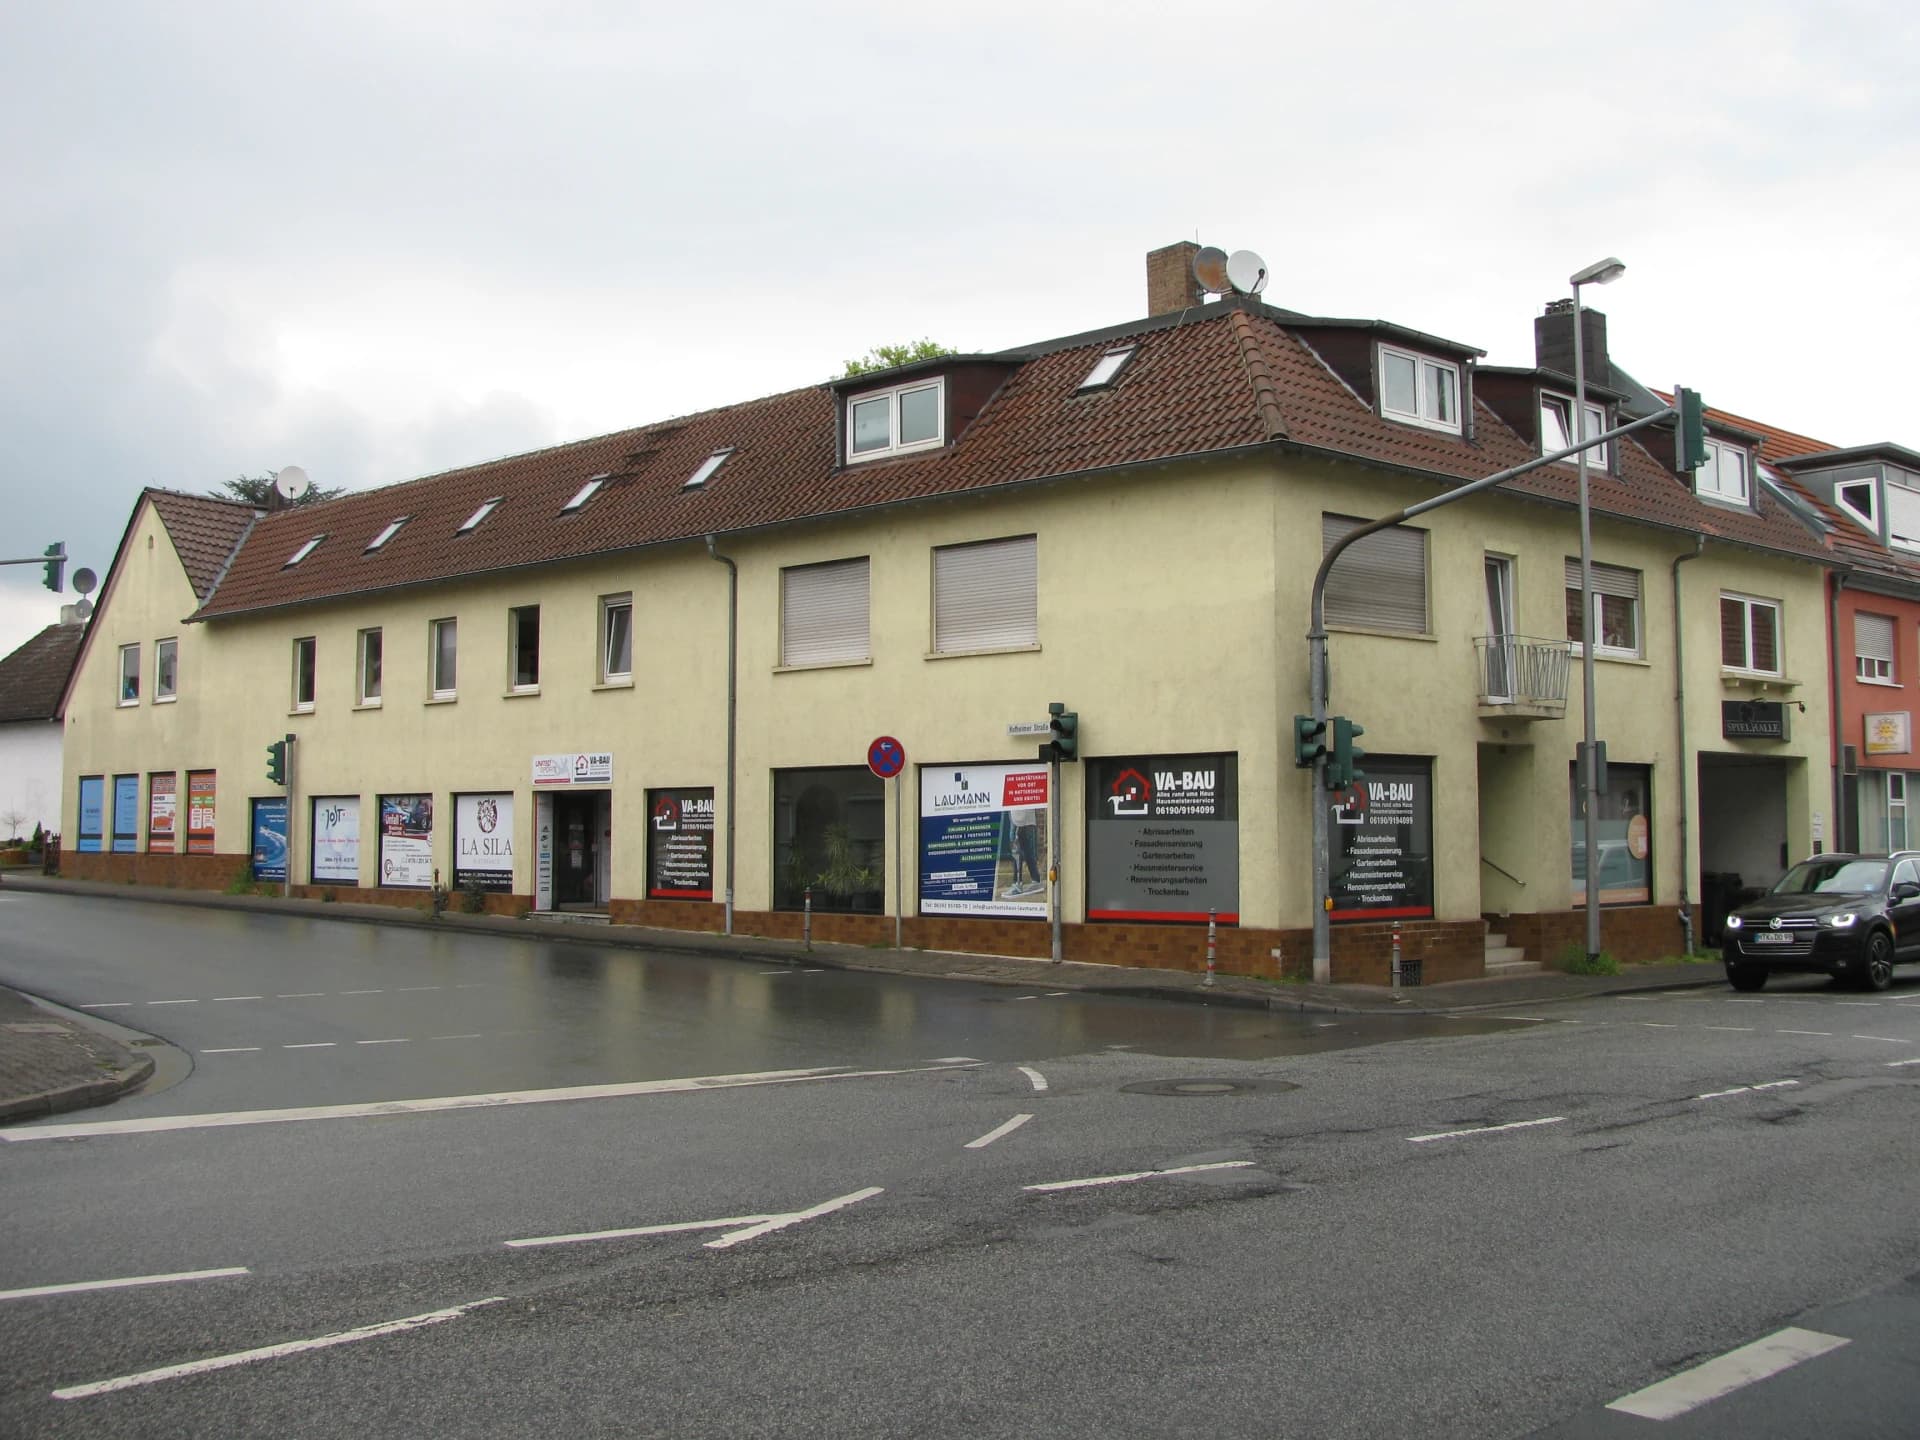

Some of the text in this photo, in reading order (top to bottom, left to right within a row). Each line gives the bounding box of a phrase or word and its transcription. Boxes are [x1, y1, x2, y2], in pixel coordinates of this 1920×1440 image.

[1154, 770, 1215, 790] VA-BAU
[1368, 783, 1413, 801] VA-BAU
[934, 792, 990, 806] LAUMANN
[1155, 805, 1215, 815] 06190/9194099
[462, 838, 512, 855] LA SILA
[1350, 847, 1402, 855] Fassadensanierung
[1356, 859, 1397, 867] Gartenarbeiten
[1134, 864, 1204, 873] Hausmeisterservice
[1350, 871, 1403, 879] Hausmeisterservice
[1148, 888, 1190, 896] Trockenbau
[1347, 883, 1406, 892] Renovierungsarbeiten
[1361, 894, 1393, 902] Trockenbau
